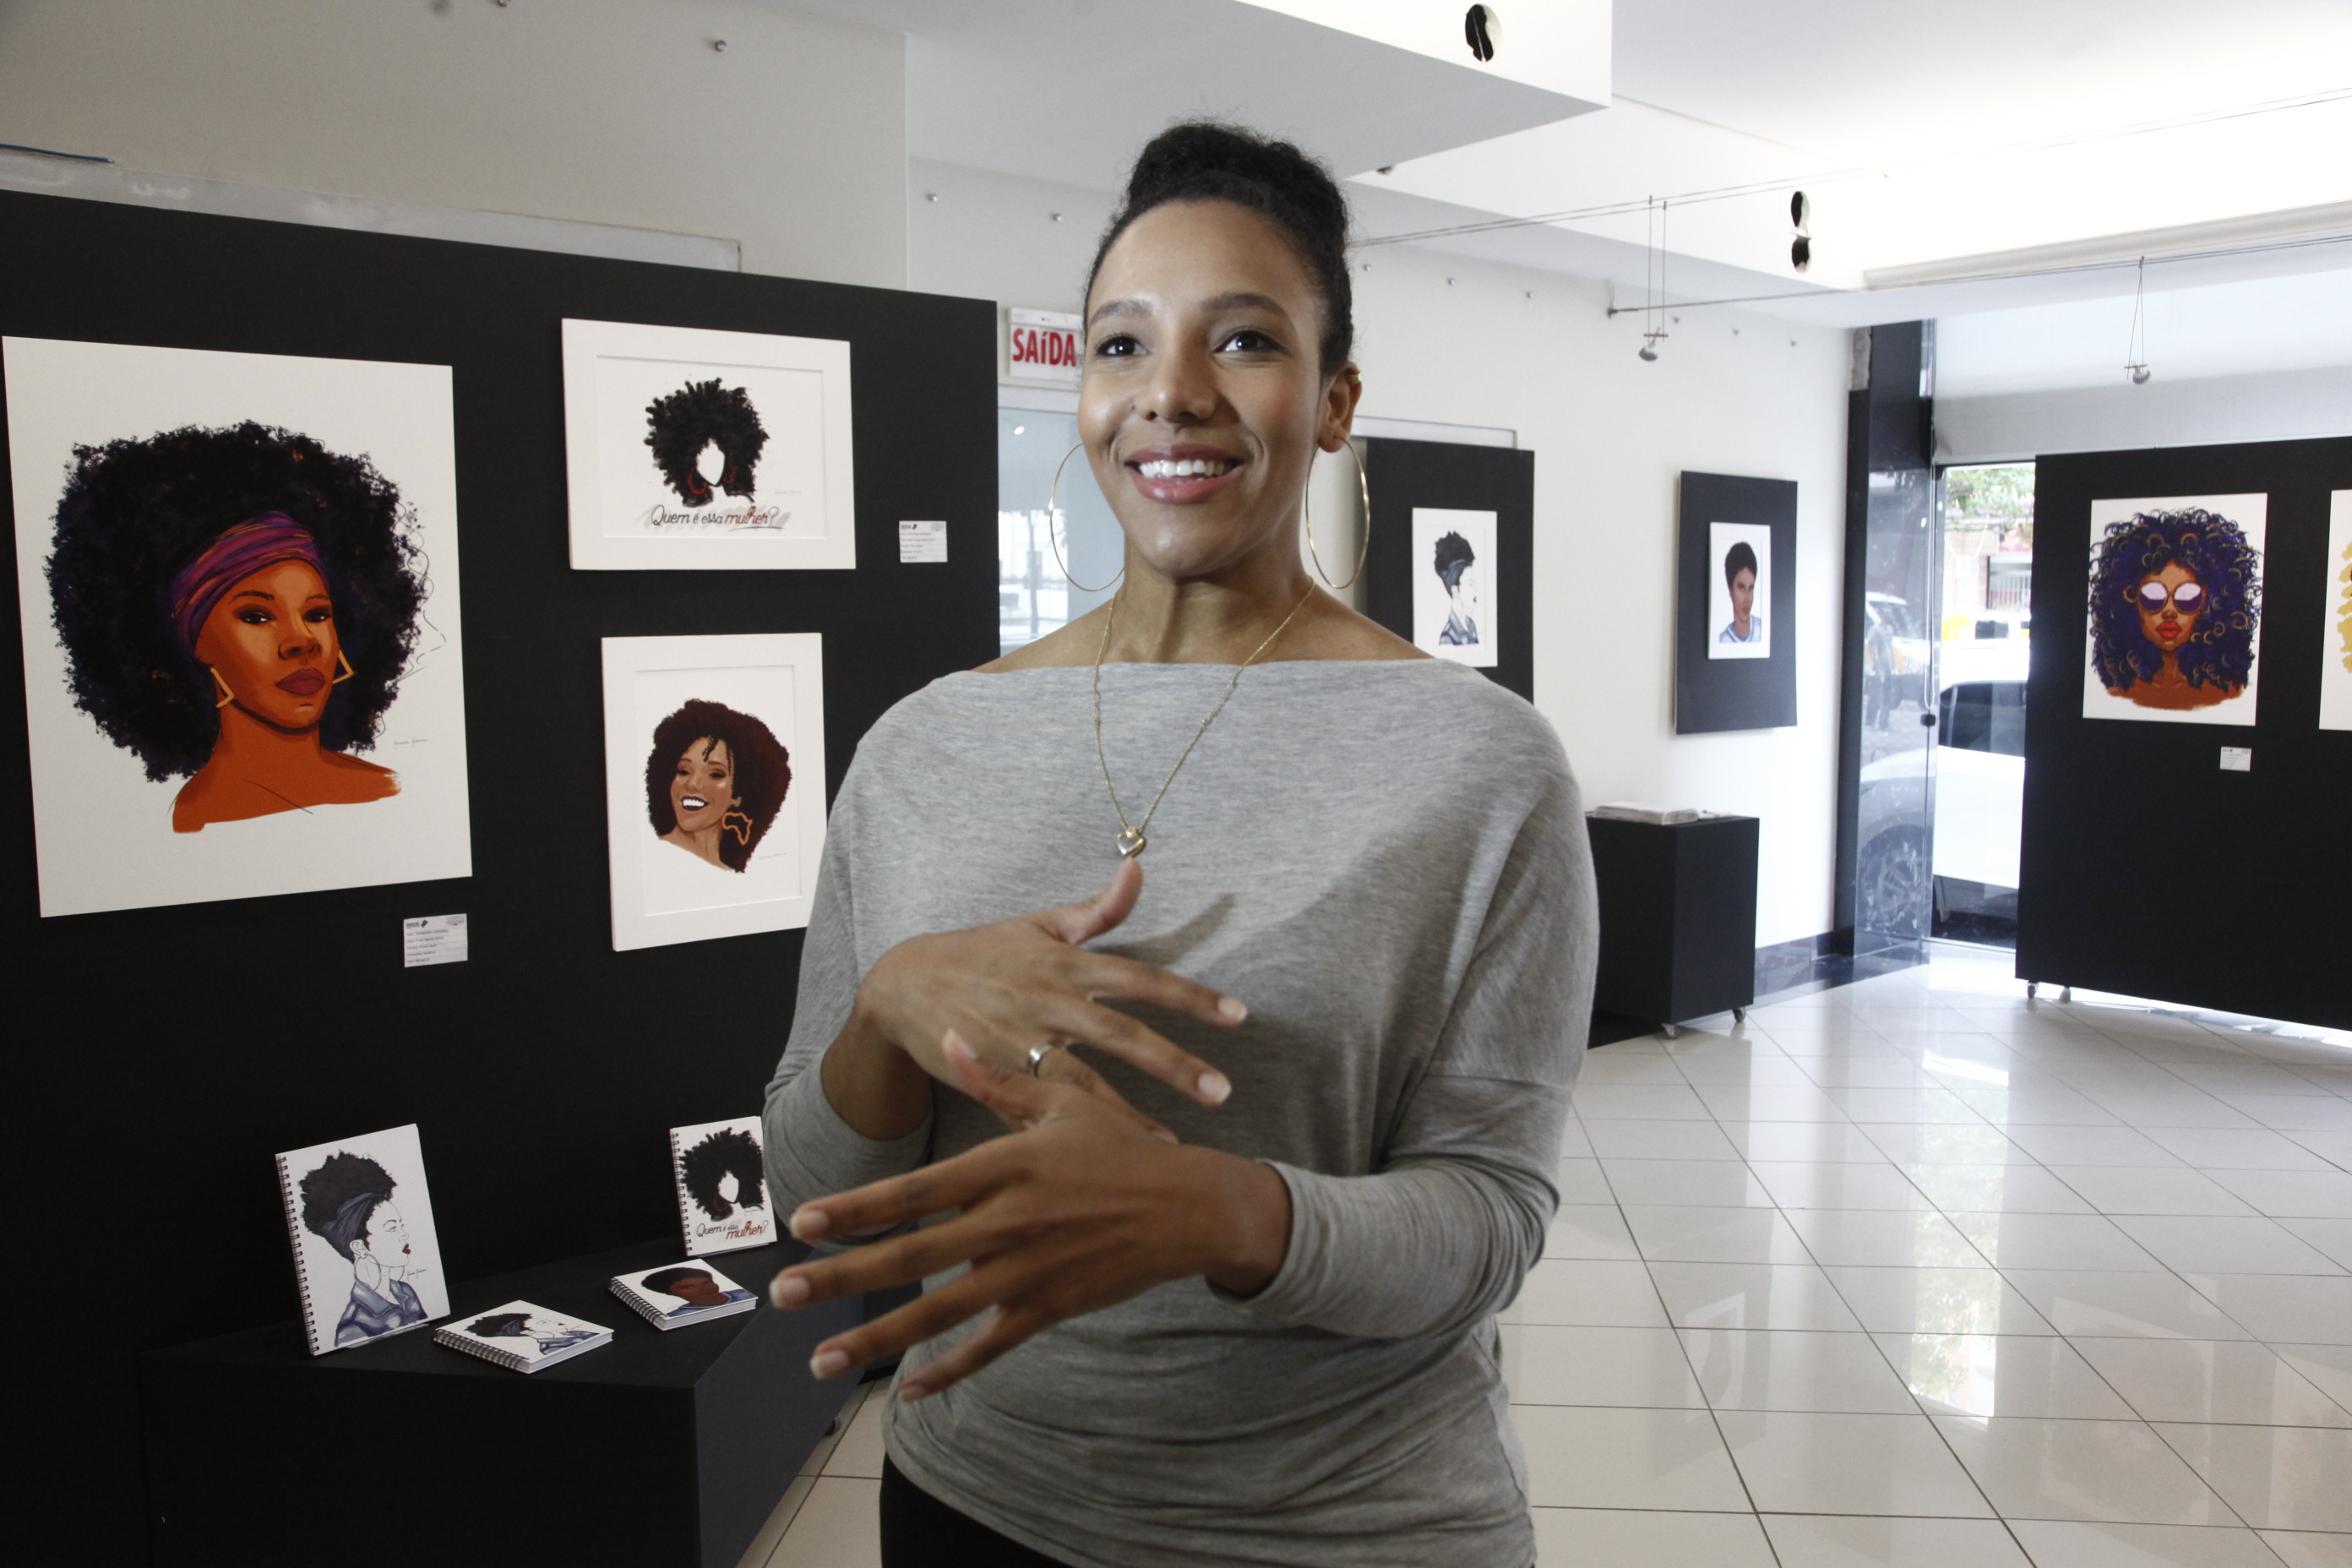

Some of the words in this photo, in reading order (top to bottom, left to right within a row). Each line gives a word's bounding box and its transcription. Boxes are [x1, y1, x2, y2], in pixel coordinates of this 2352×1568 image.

[651, 504, 689, 525] Quem
[693, 512, 700, 524] é
[701, 512, 723, 525] essa
[724, 506, 779, 525] mulher?
[697, 1223, 721, 1237] Quem
[726, 1220, 769, 1239] mulher?
